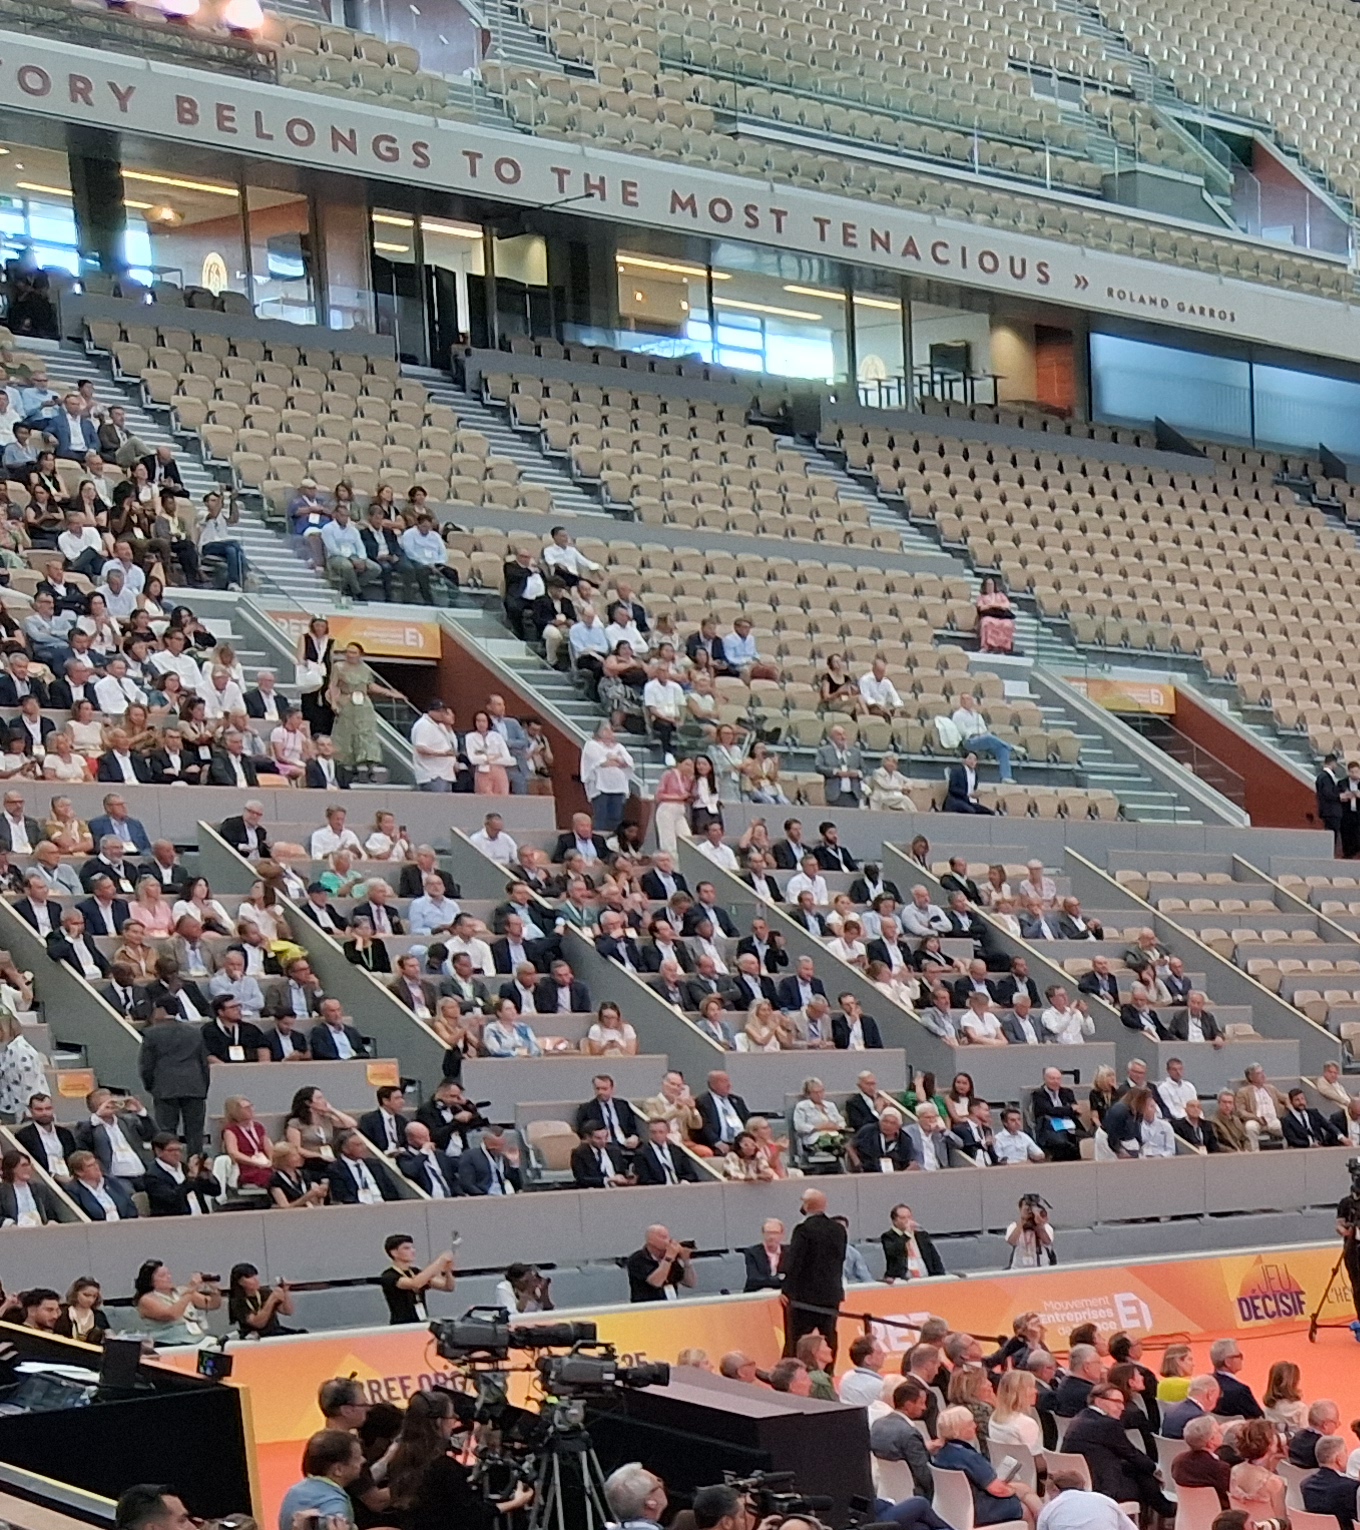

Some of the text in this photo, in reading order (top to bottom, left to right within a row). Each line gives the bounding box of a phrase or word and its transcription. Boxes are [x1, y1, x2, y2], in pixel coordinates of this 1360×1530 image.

[0, 60, 136, 113] ORY
[175, 94, 432, 170] BELONGS
[462, 150, 521, 185] TO
[550, 166, 640, 208] THE
[670, 190, 788, 234] MOST
[814, 214, 1052, 287] TENACIOUS
[1107, 286, 1236, 323] ROLAND GARROS
[1256, 1263, 1293, 1294] JEU
[1043, 1296, 1111, 1311] Mouvement
[1236, 1287, 1307, 1323] DÉCISIF
